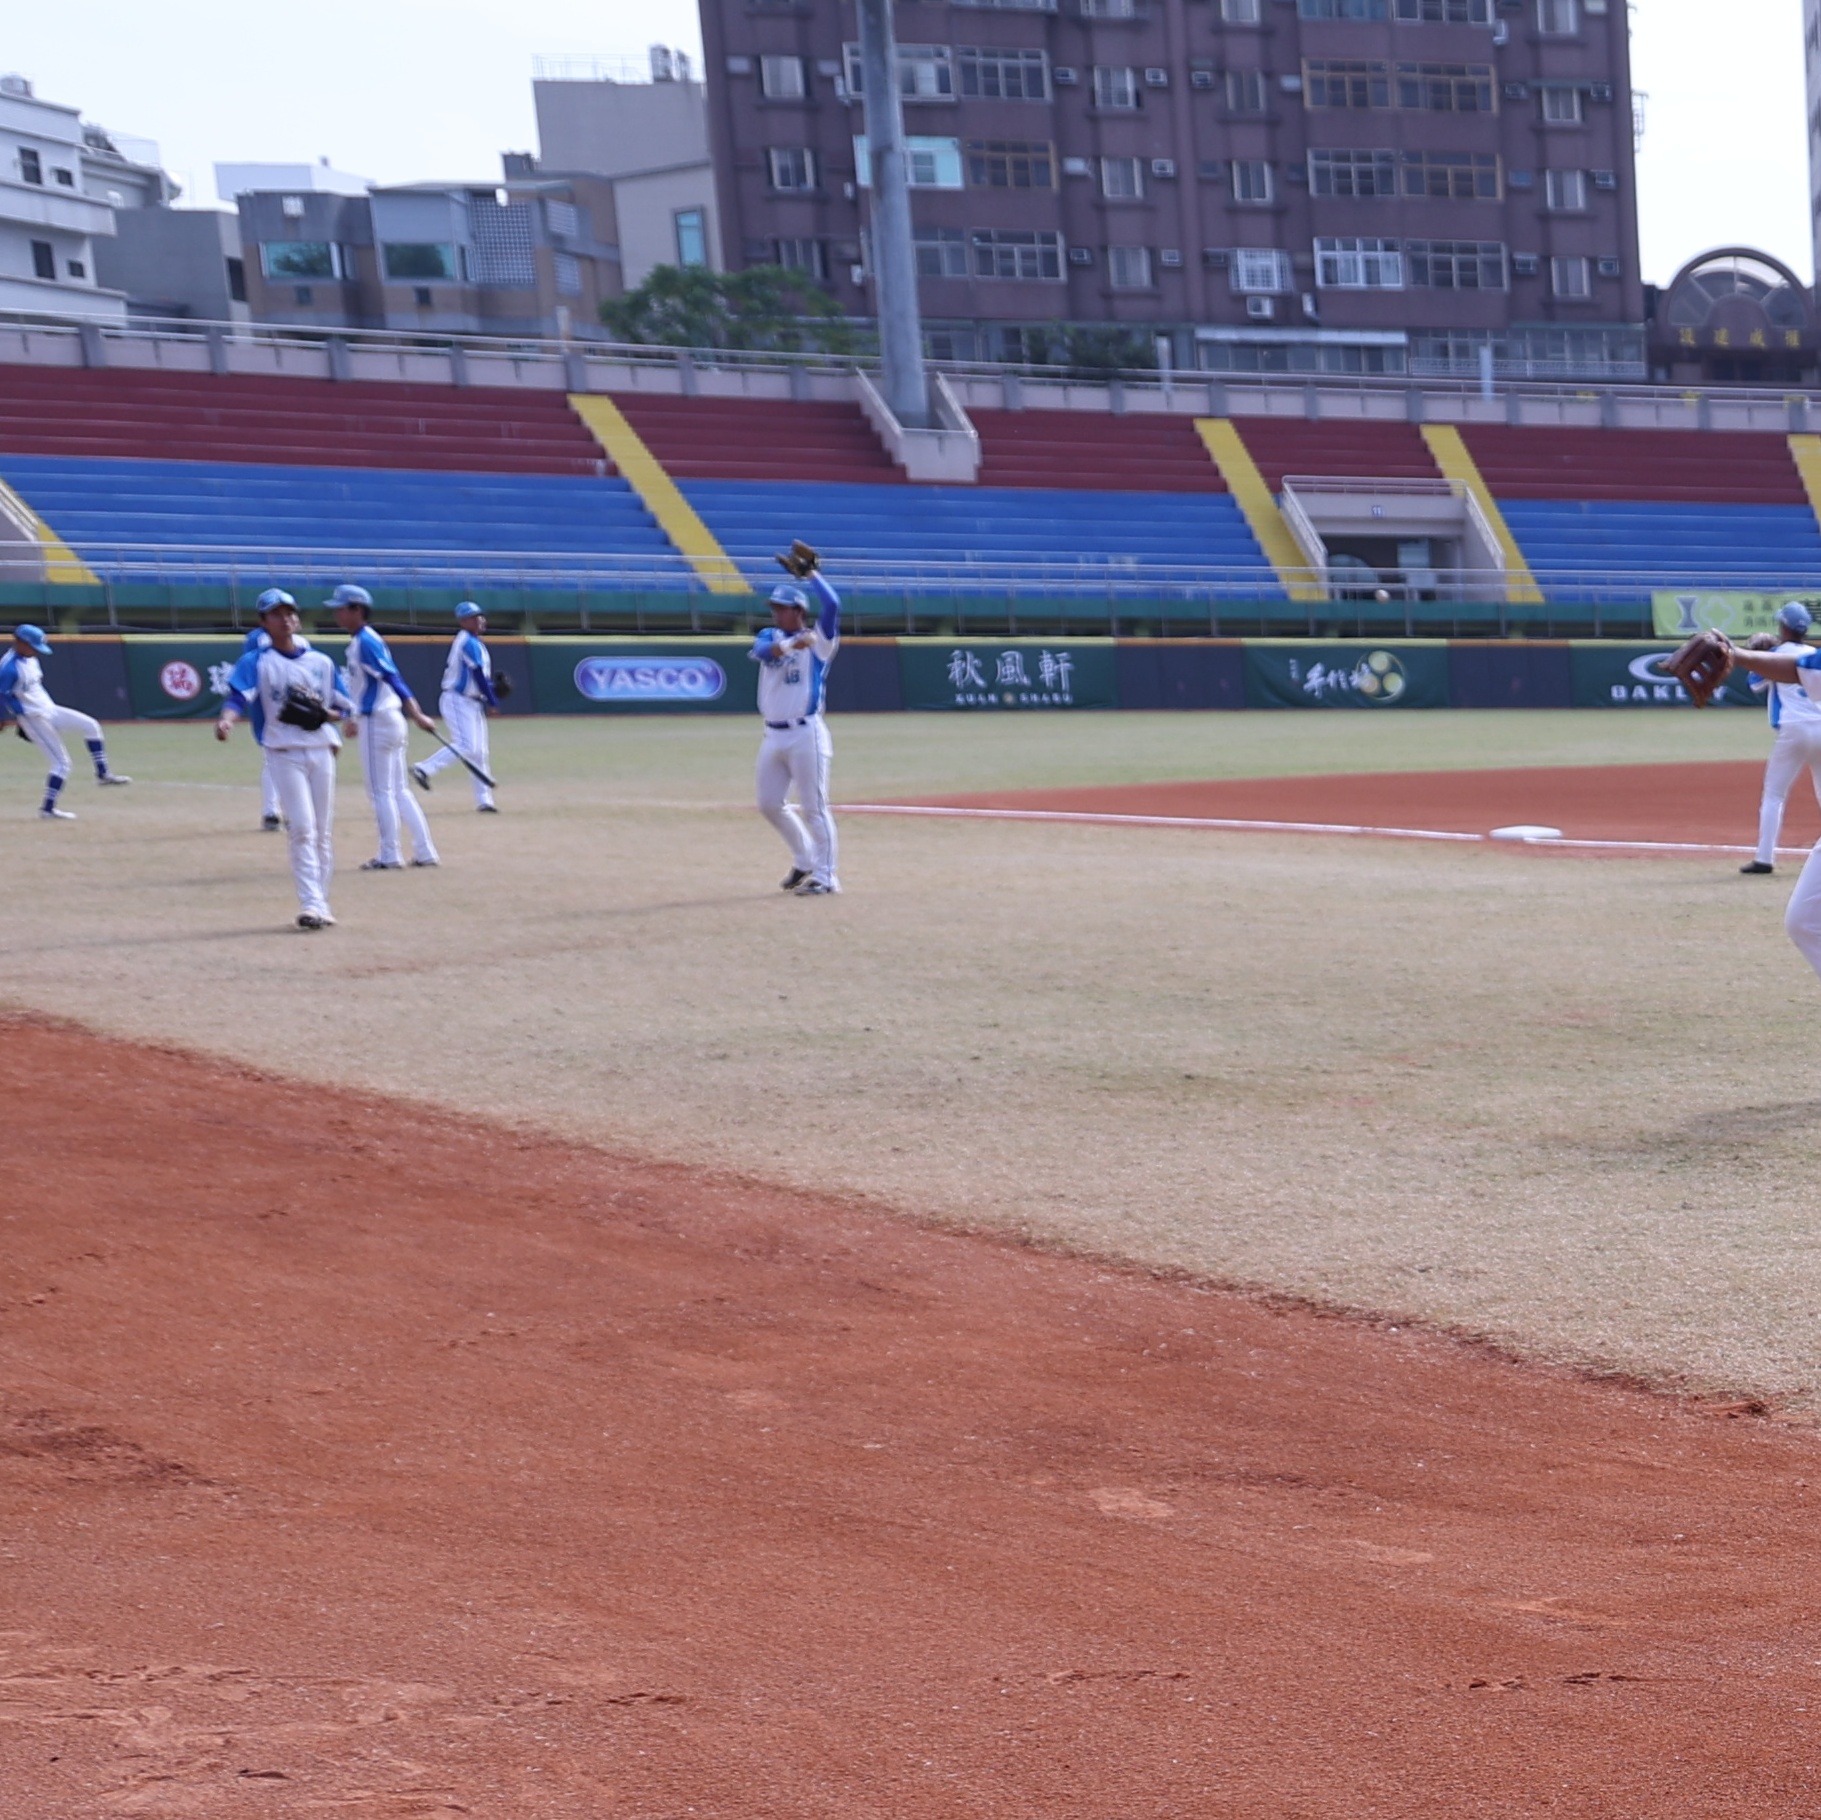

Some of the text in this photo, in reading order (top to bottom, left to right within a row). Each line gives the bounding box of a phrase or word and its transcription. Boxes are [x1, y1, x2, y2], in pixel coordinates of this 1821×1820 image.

[588, 666, 701, 691] YASCO
[947, 650, 1075, 690] 秋風軒
[1610, 683, 1728, 700] OAKLY
